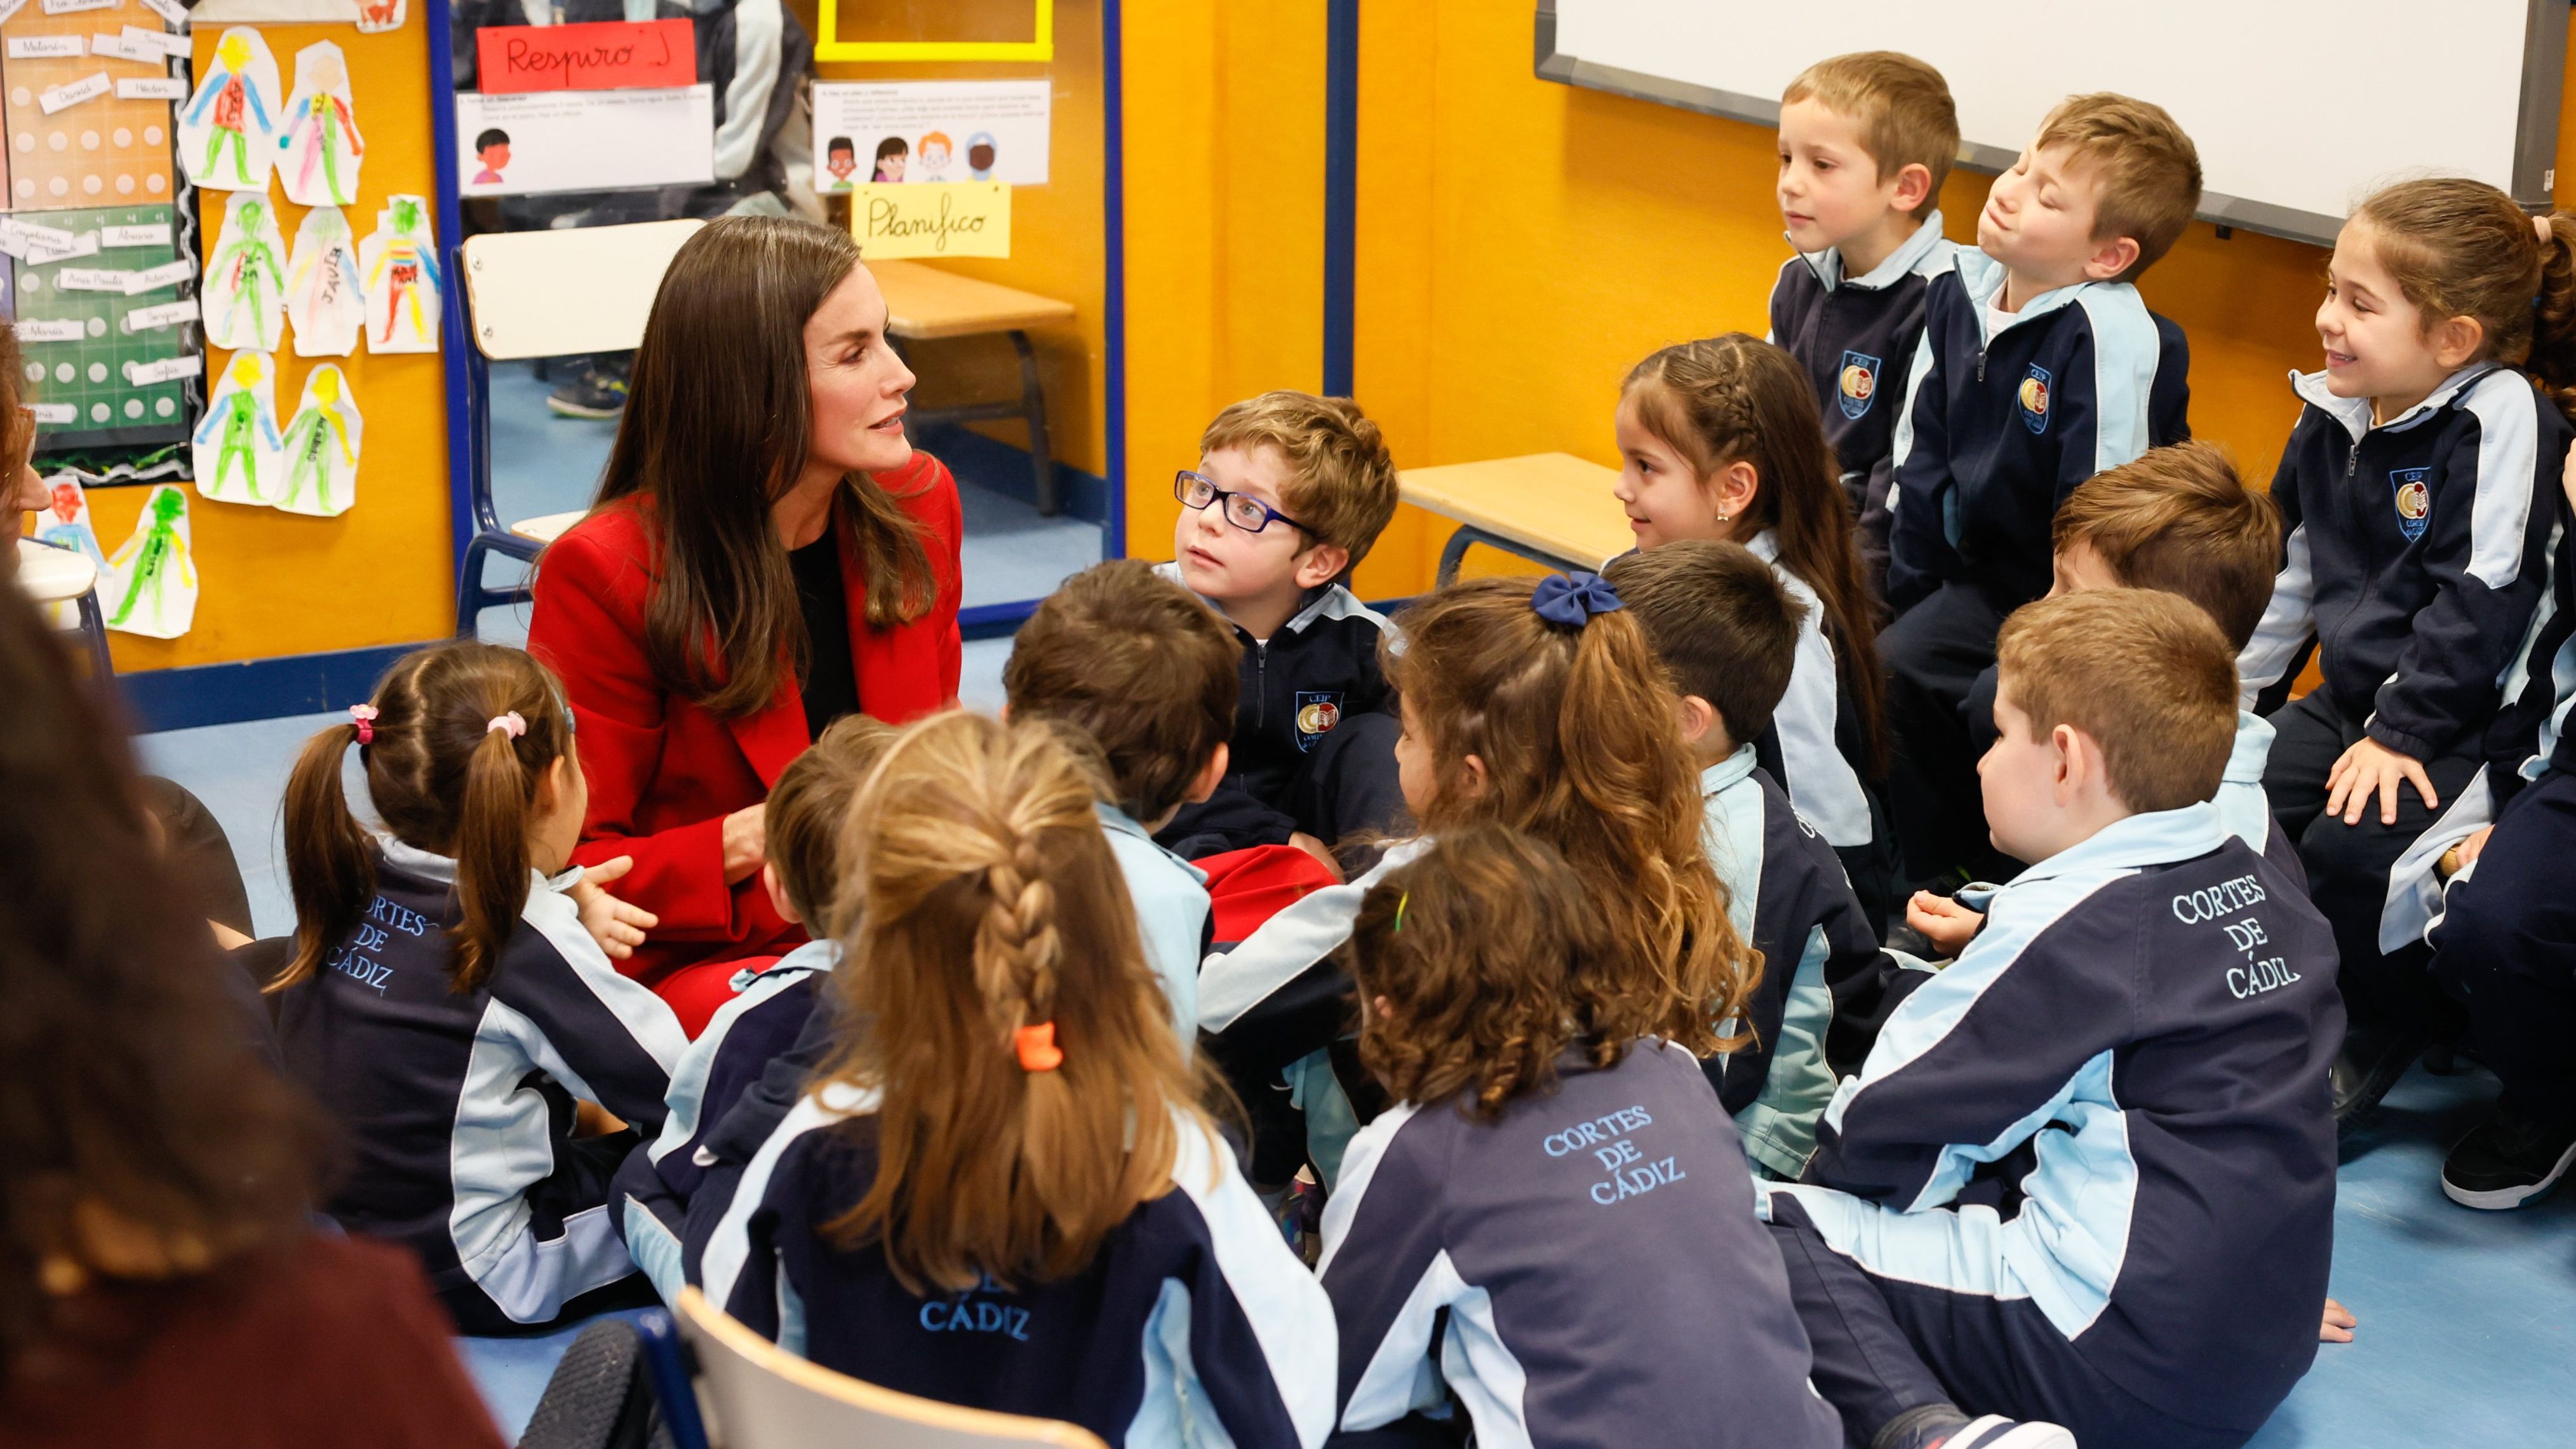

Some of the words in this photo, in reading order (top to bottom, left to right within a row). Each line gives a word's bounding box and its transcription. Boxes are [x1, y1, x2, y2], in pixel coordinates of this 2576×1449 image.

[507, 38, 634, 87] Respiro
[868, 192, 986, 252] Planifico
[365, 894, 427, 936] RTES
[2172, 874, 2267, 925] CORTES
[354, 923, 389, 952] DE
[2223, 917, 2269, 952] DE
[326, 947, 394, 989] CÁDIZ
[1543, 1105, 1653, 1157] CORTES
[1593, 1139, 1643, 1172] DE
[1590, 1156, 1687, 1205] CÁDIZ
[919, 1292, 1031, 1342] CÁDIZ
